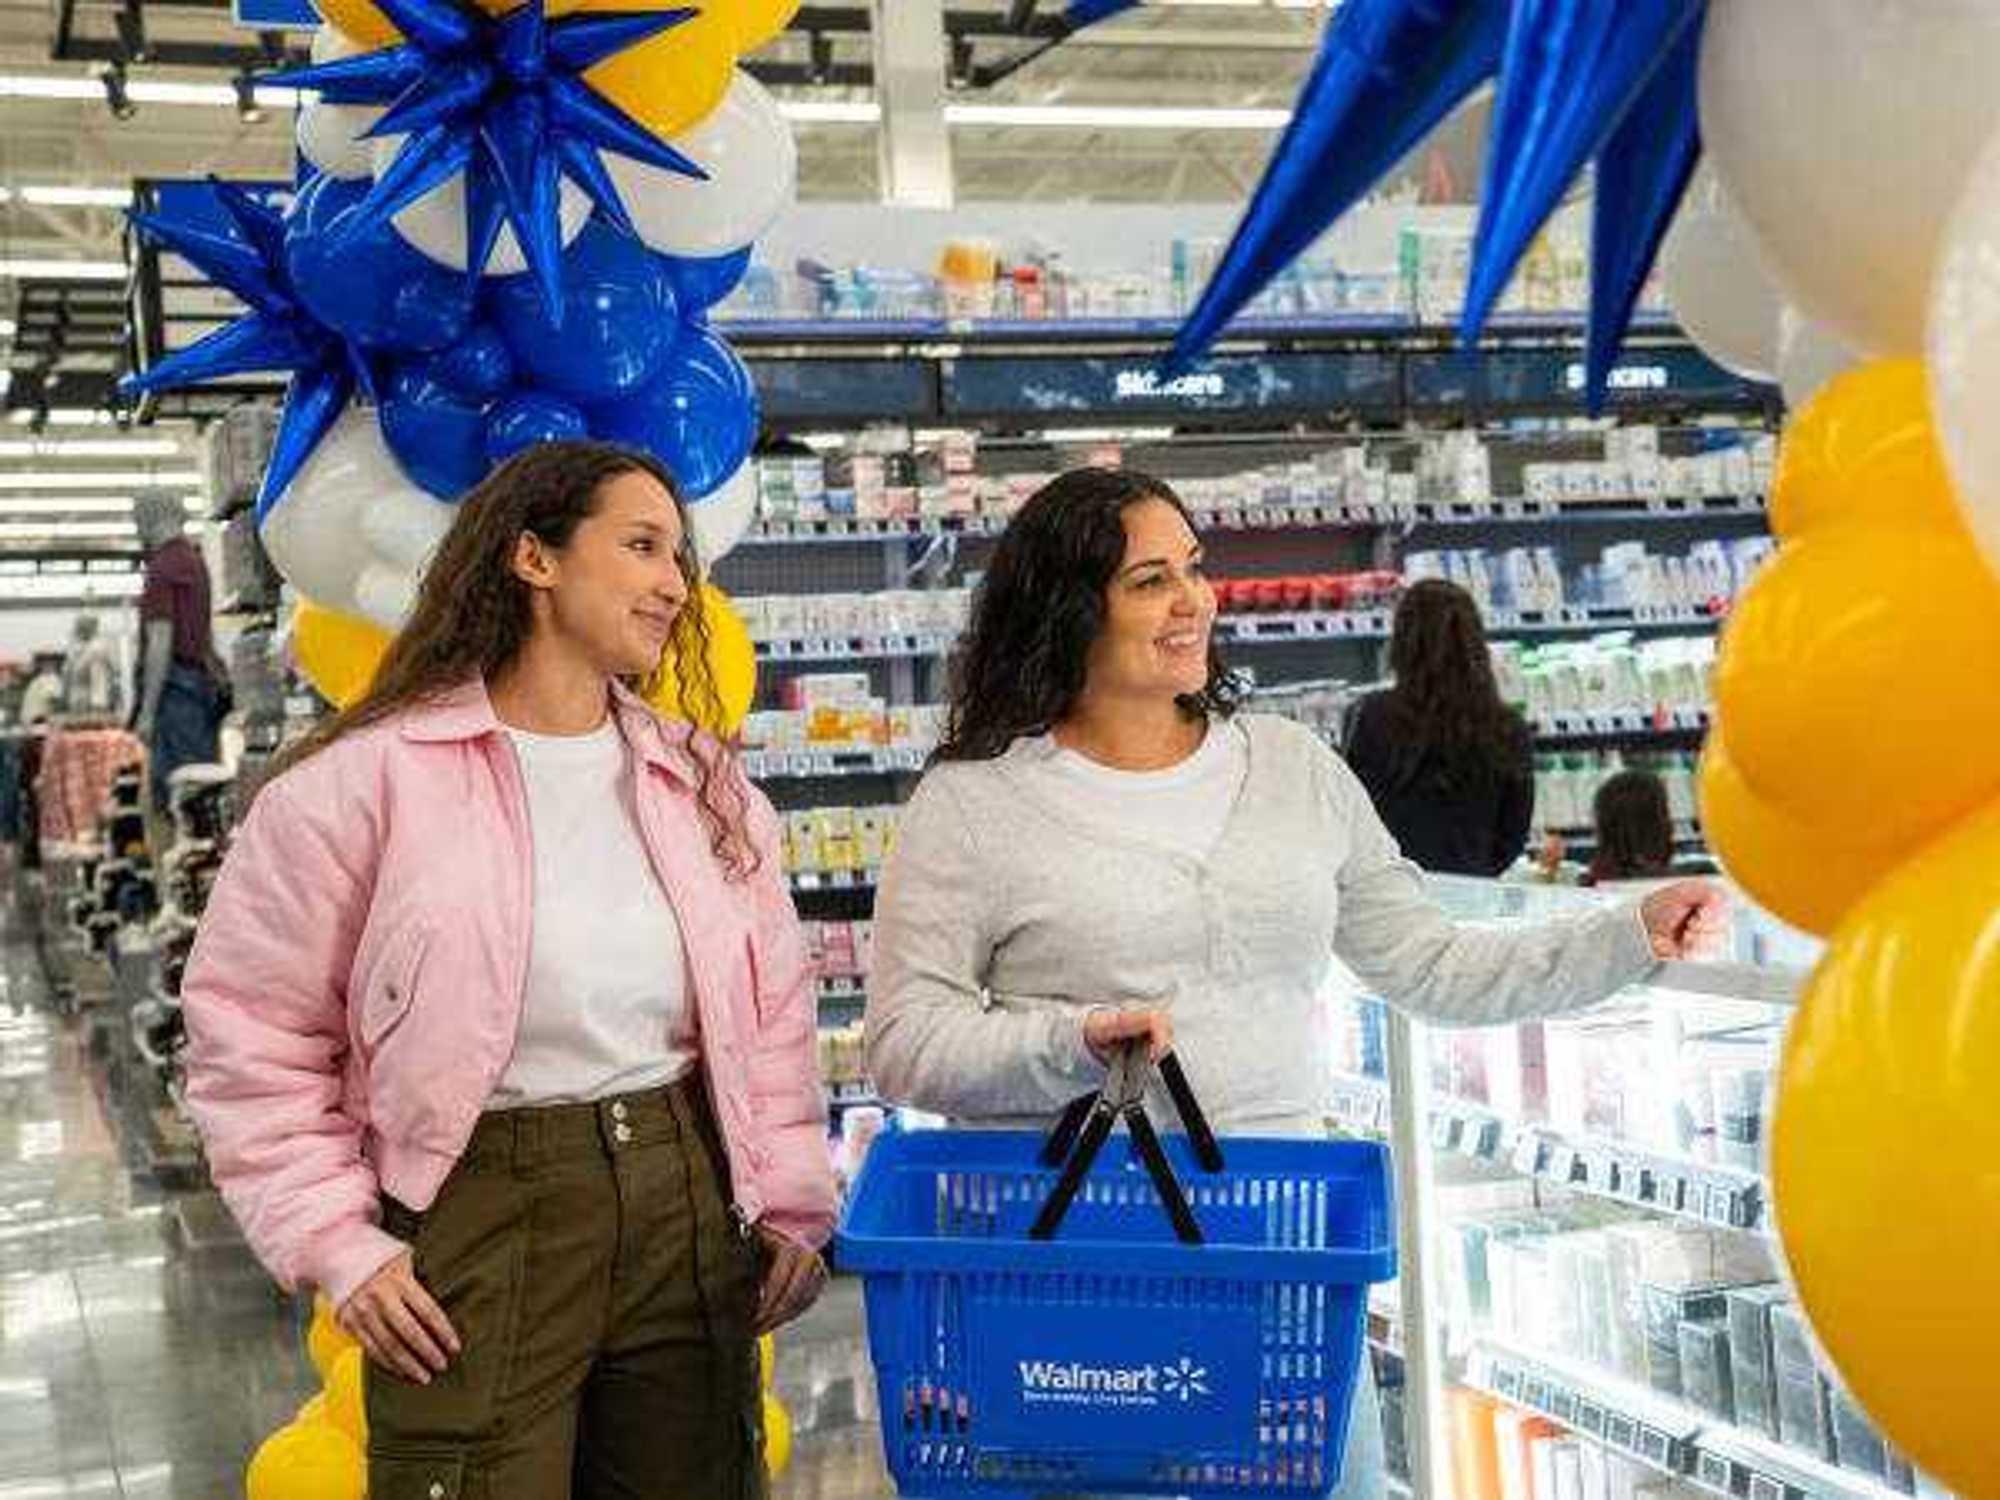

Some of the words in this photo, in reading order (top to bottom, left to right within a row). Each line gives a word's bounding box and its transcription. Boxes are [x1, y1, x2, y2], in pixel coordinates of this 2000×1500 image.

[1117, 370, 1224, 394] Skcare
[1567, 364, 1668, 388] Sncare
[1019, 1361, 1157, 1391] Walmart
